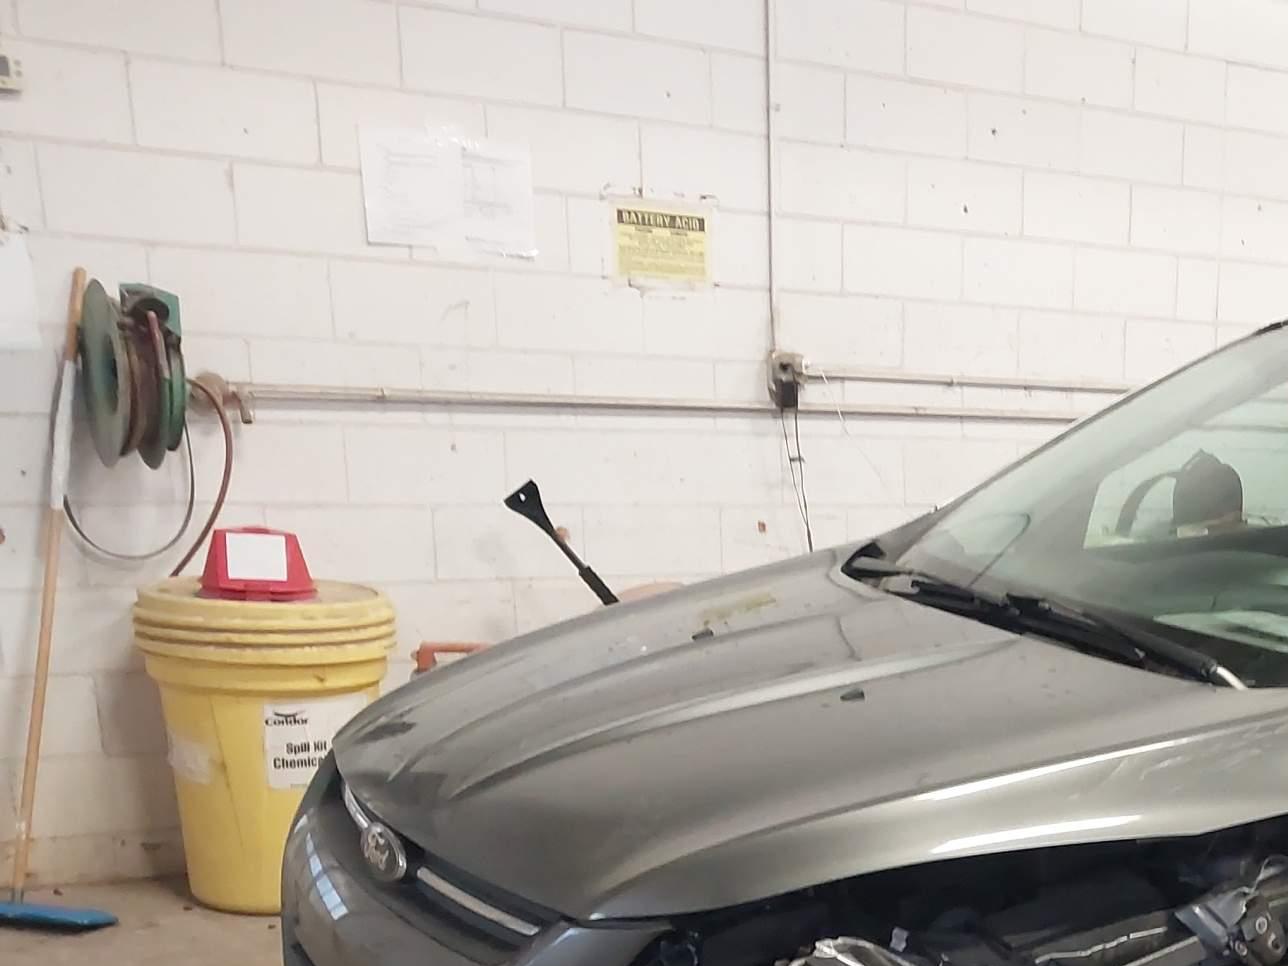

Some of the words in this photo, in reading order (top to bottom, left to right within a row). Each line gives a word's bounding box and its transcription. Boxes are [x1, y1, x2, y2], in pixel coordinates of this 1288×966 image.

[622, 209, 671, 227] BATTERY
[675, 215, 700, 232] ACID
[265, 714, 309, 727] Condor
[286, 742, 310, 755] Spill
[313, 740, 327, 752] Kit
